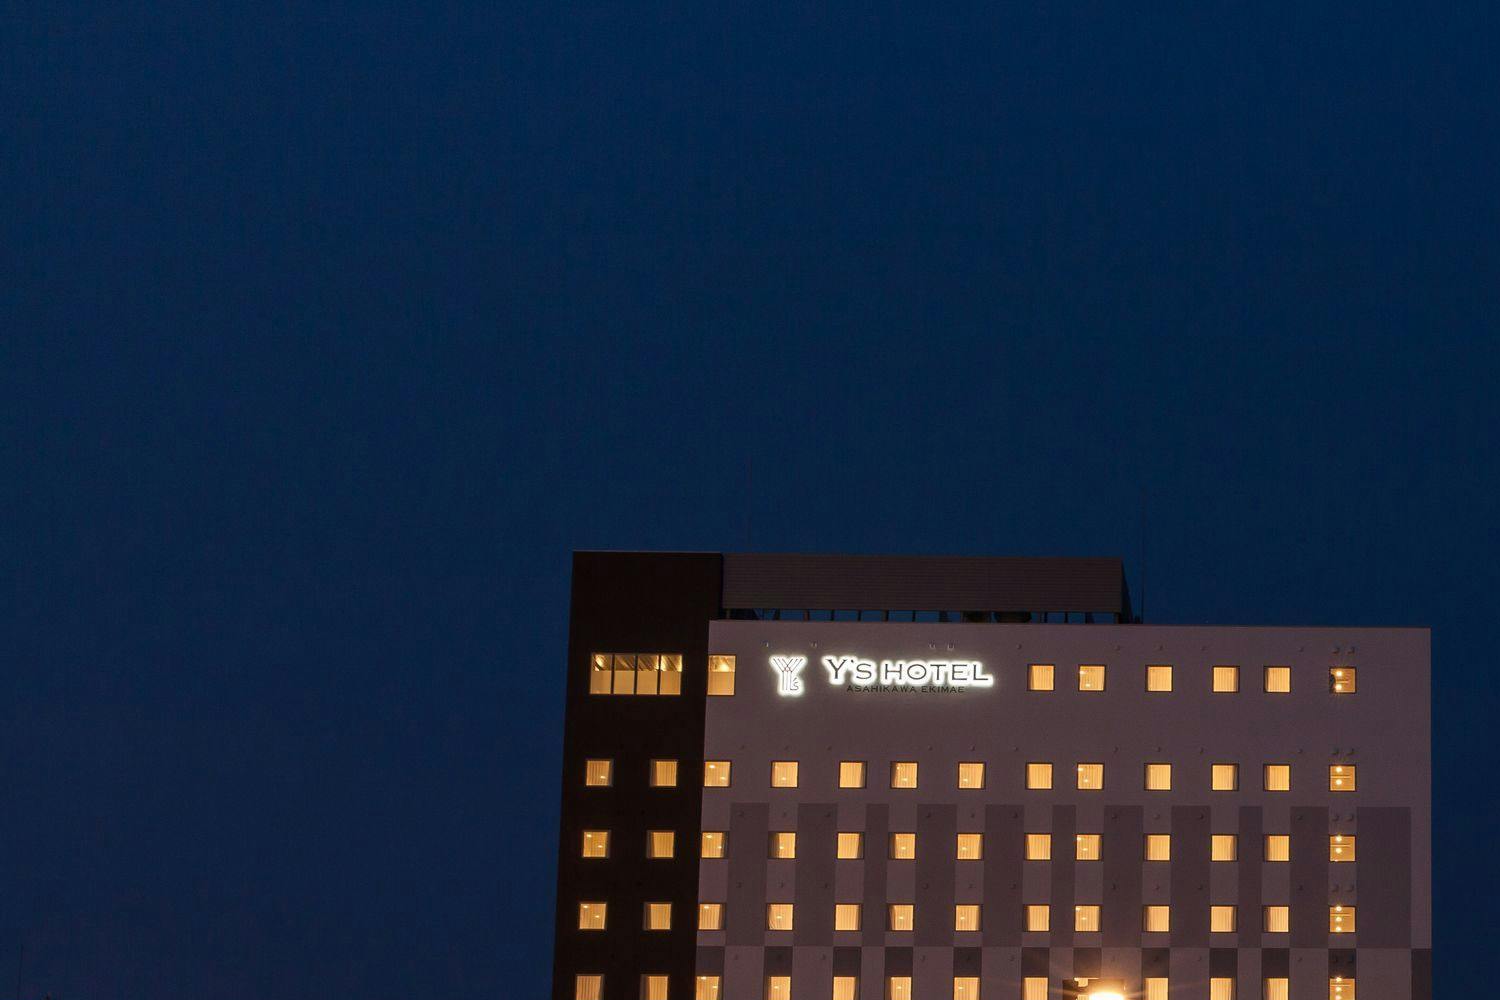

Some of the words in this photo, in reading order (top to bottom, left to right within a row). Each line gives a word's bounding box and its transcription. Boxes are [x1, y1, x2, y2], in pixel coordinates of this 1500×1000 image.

[883, 661, 990, 684] HOTEL
[846, 684, 916, 694] ASAHIKAWA
[921, 684, 966, 694] EKIMAE
